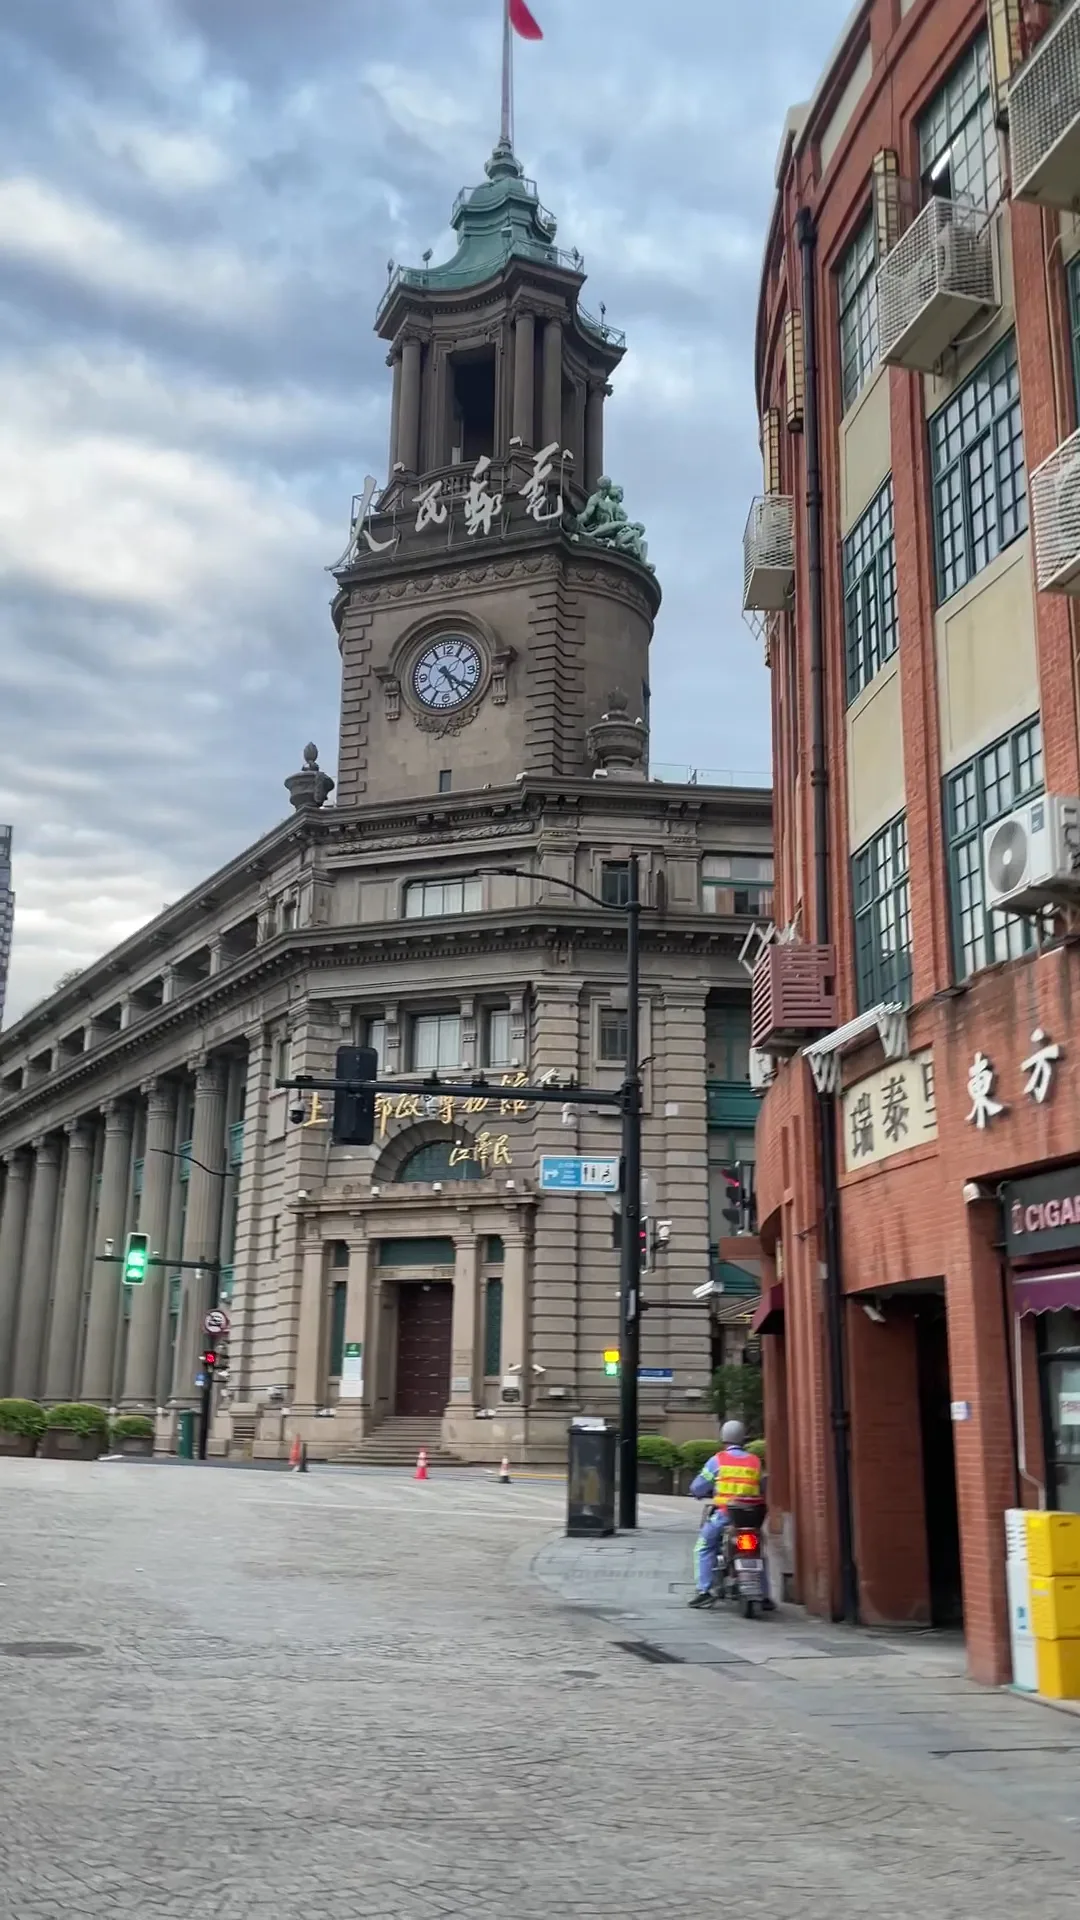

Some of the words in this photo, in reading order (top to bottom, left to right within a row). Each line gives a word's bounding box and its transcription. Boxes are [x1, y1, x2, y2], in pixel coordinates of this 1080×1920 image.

[443, 646, 454, 655] 12
[467, 665, 476, 674] 3
[418, 673, 428, 683] 9
[441, 693, 451, 703] 6
[964, 1027, 1060, 1130] 東方
